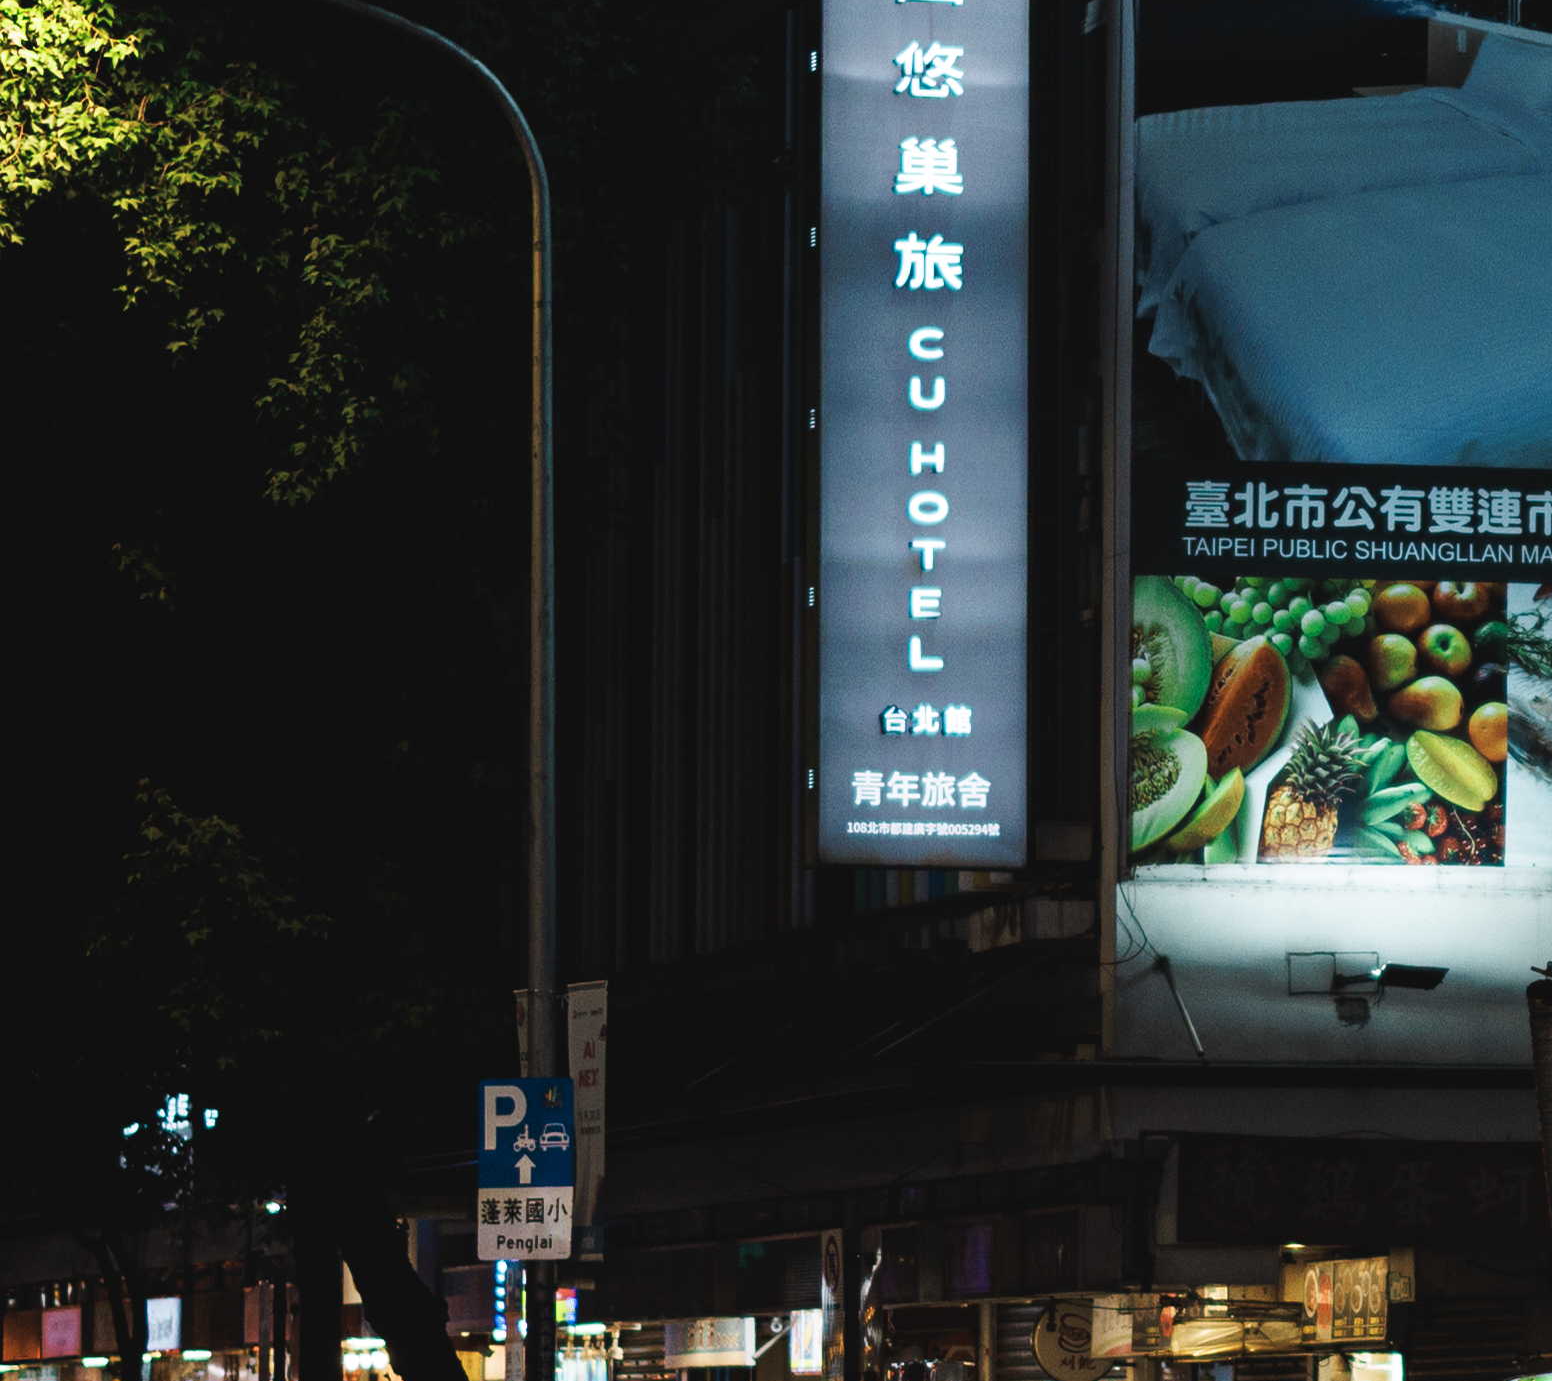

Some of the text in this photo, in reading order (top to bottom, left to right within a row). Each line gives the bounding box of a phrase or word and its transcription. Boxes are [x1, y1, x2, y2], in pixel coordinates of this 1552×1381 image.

[907, 326, 950, 673] CU HOTEL
[1182, 536, 1254, 558] TAIPEI
[1263, 539, 1348, 560] PUBLIC
[883, 704, 972, 734] 台北館
[852, 770, 991, 808] 青年旅舍
[484, 1084, 528, 1151] P
[480, 1197, 568, 1225] 蓬萊國小
[496, 1235, 553, 1254] Penglai
